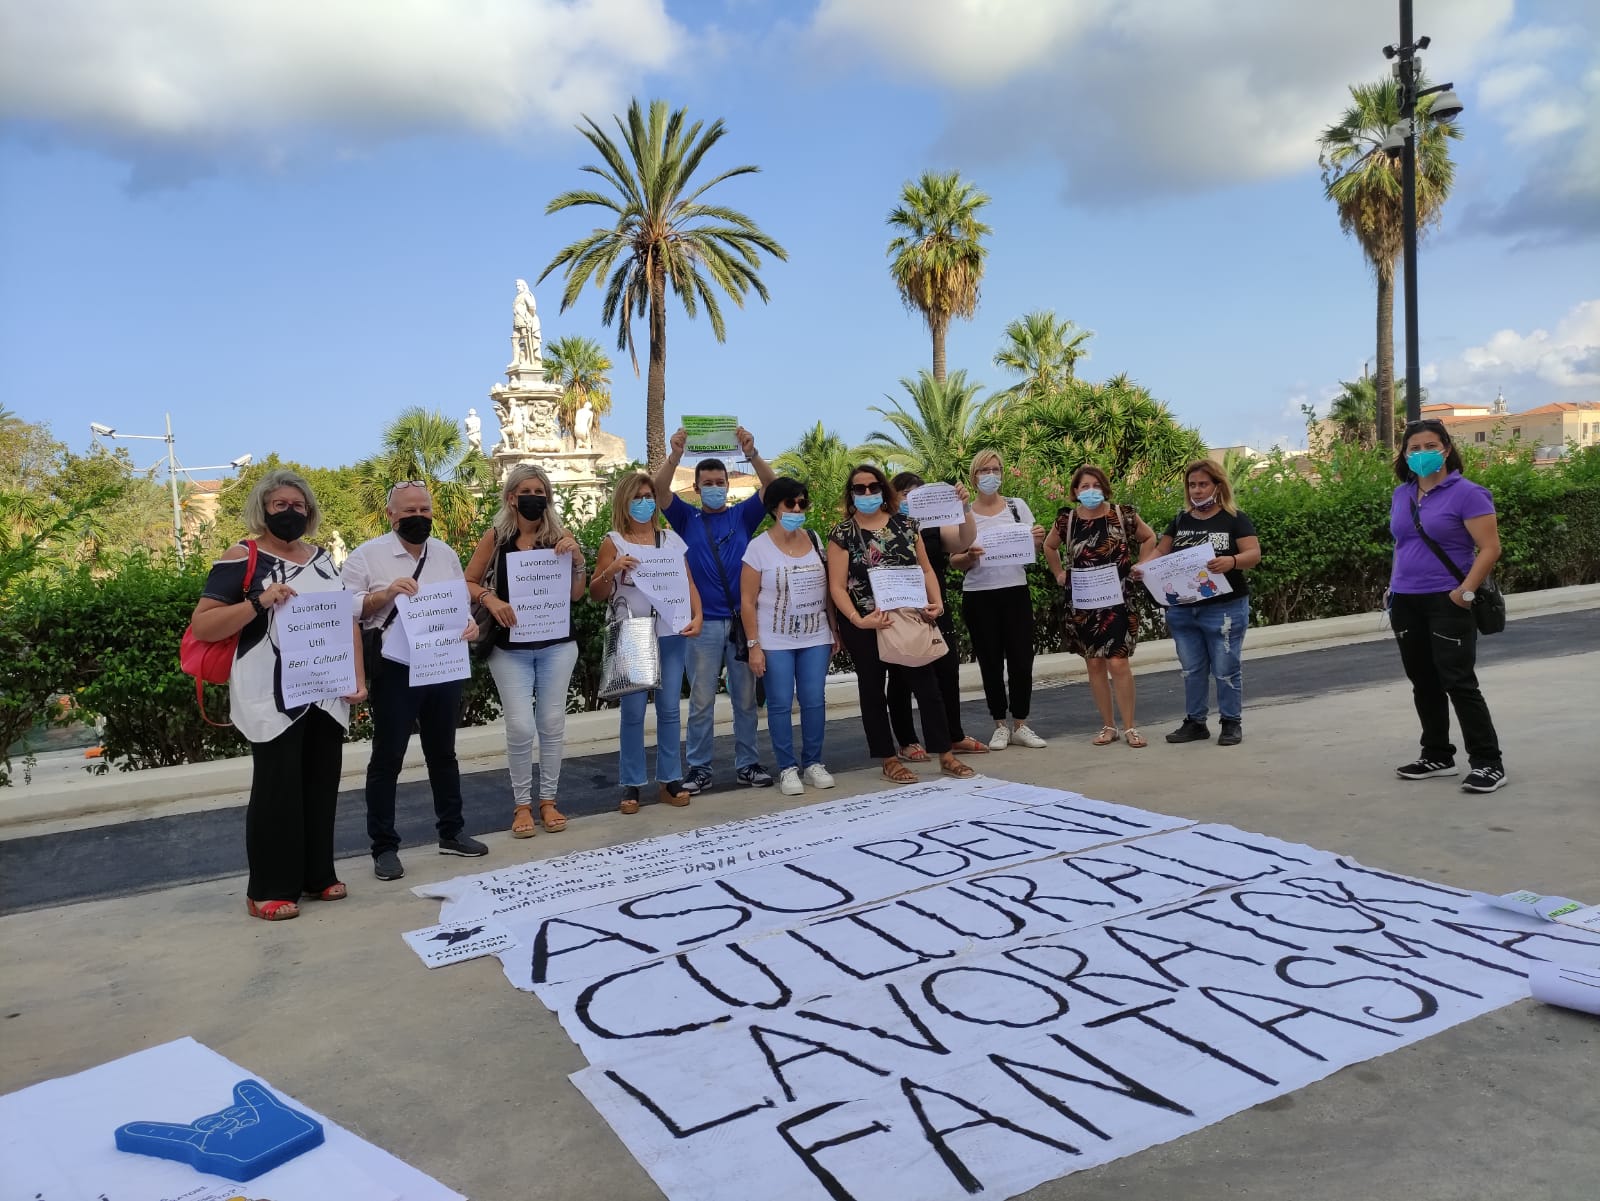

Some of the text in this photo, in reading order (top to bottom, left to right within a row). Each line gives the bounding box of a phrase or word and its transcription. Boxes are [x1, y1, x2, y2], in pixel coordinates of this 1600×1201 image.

[520, 558, 560, 568] Lavoratori
[641, 556, 675, 565] Lavoratori
[515, 573, 562, 582] Socialmente
[636, 570, 680, 579] Socialmente
[408, 589, 453, 604] Lavoratori
[533, 587, 549, 596] Utili
[291, 601, 338, 614] Lavoratori
[407, 606, 458, 620] Socialmente
[516, 603, 542, 612] Museo
[287, 619, 341, 633] Socialmente
[428, 623, 445, 633] Utili
[308, 637, 326, 648] Utili
[415, 641, 432, 650] Beni
[288, 651, 348, 669] Beni Culturali
[531, 804, 1152, 984] ASU BENI
[575, 830, 1313, 1039] CULTURALI
[427, 934, 508, 958] LAVORATORI
[436, 940, 508, 961] FANTASMA
[603, 858, 1473, 1139] LAVORATORI
[776, 918, 1600, 1201] FANTASMA
